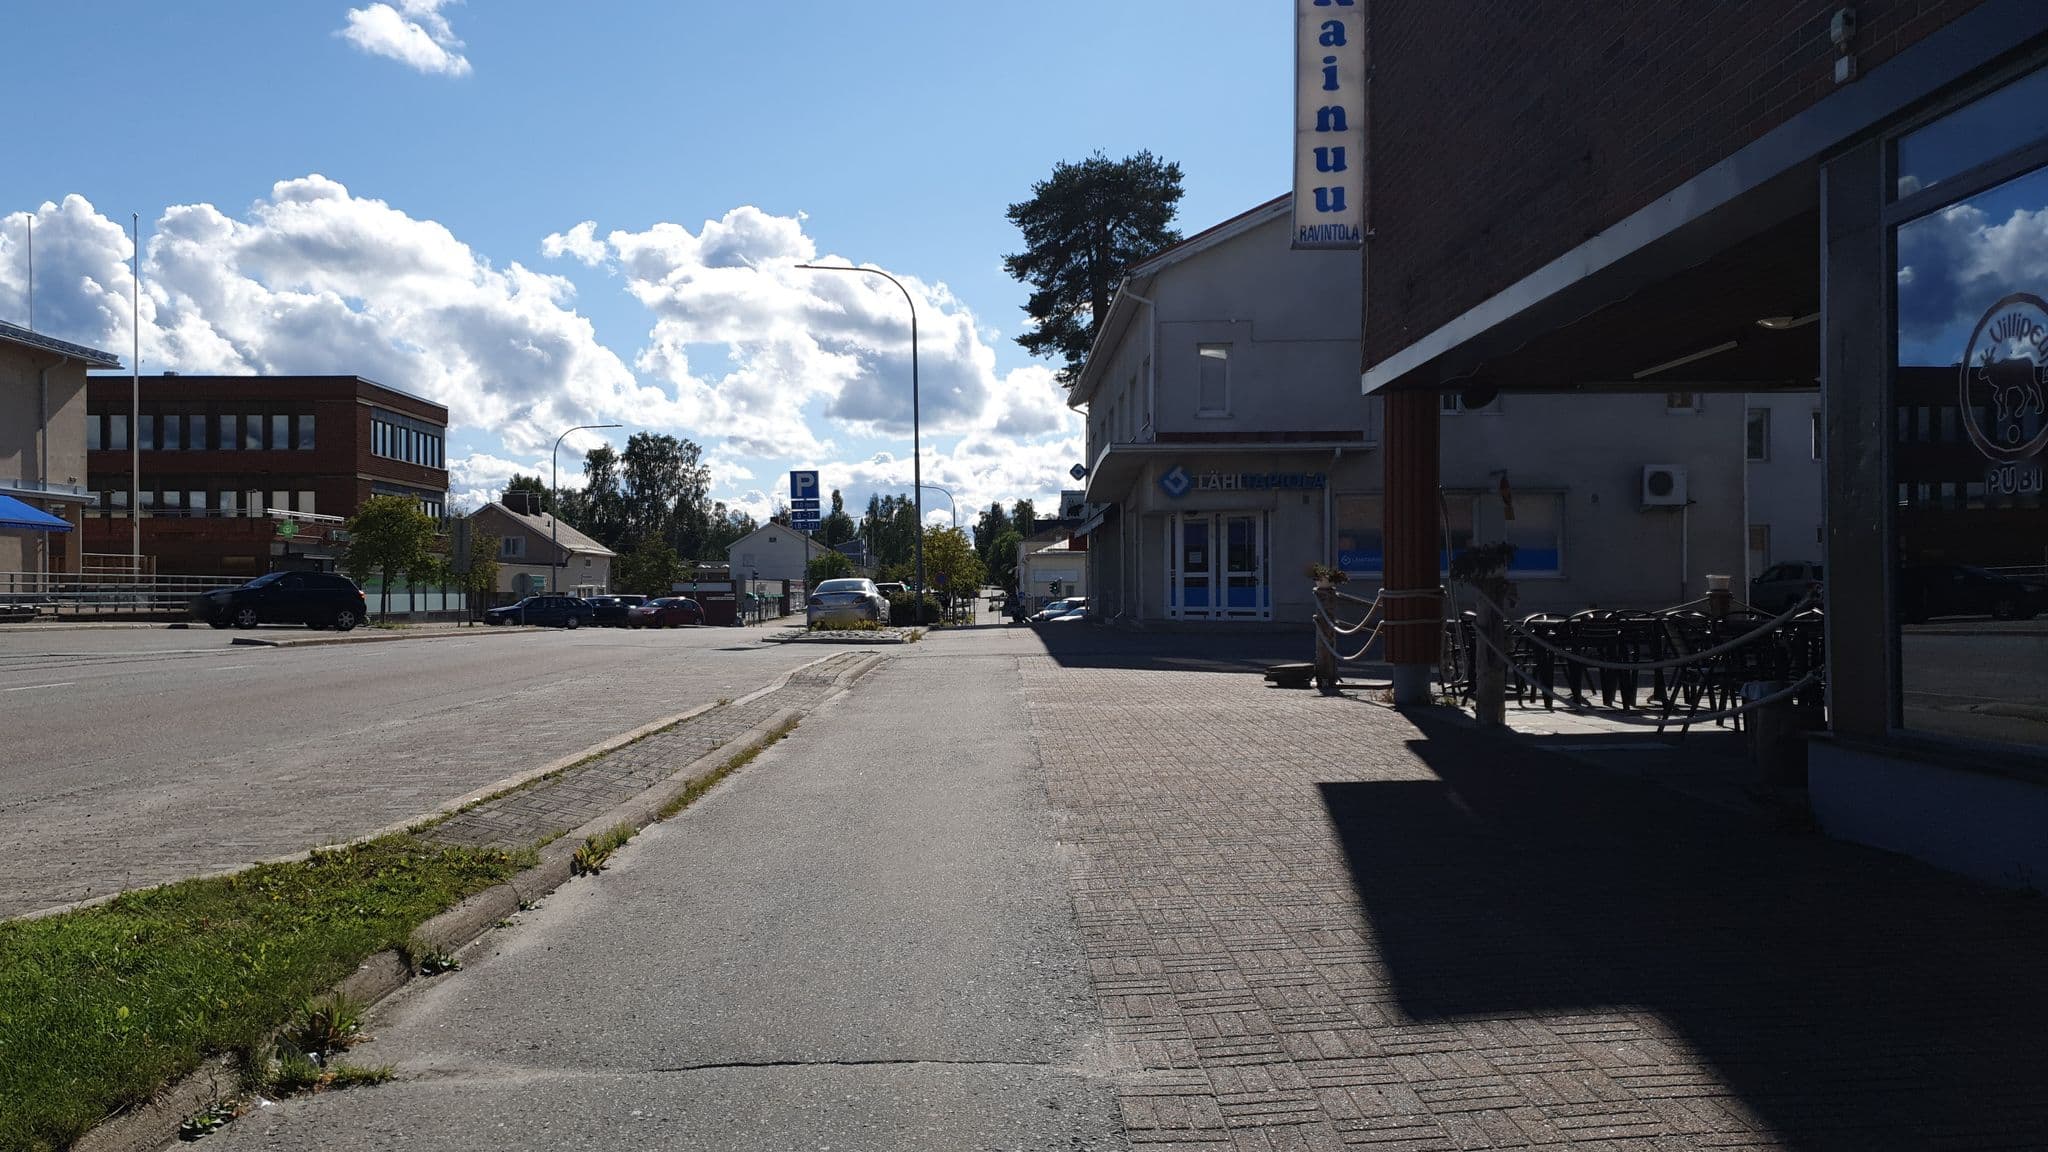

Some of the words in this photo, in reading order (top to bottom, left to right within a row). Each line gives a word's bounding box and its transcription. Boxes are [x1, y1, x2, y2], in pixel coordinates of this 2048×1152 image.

[1313, 0, 1354, 213] ainuu
[1299, 223, 1360, 241] RAVINTOLA
[796, 472, 815, 497] P
[1198, 469, 1326, 489] LÄHITAPIOLA
[1985, 465, 2042, 495] PUBI
